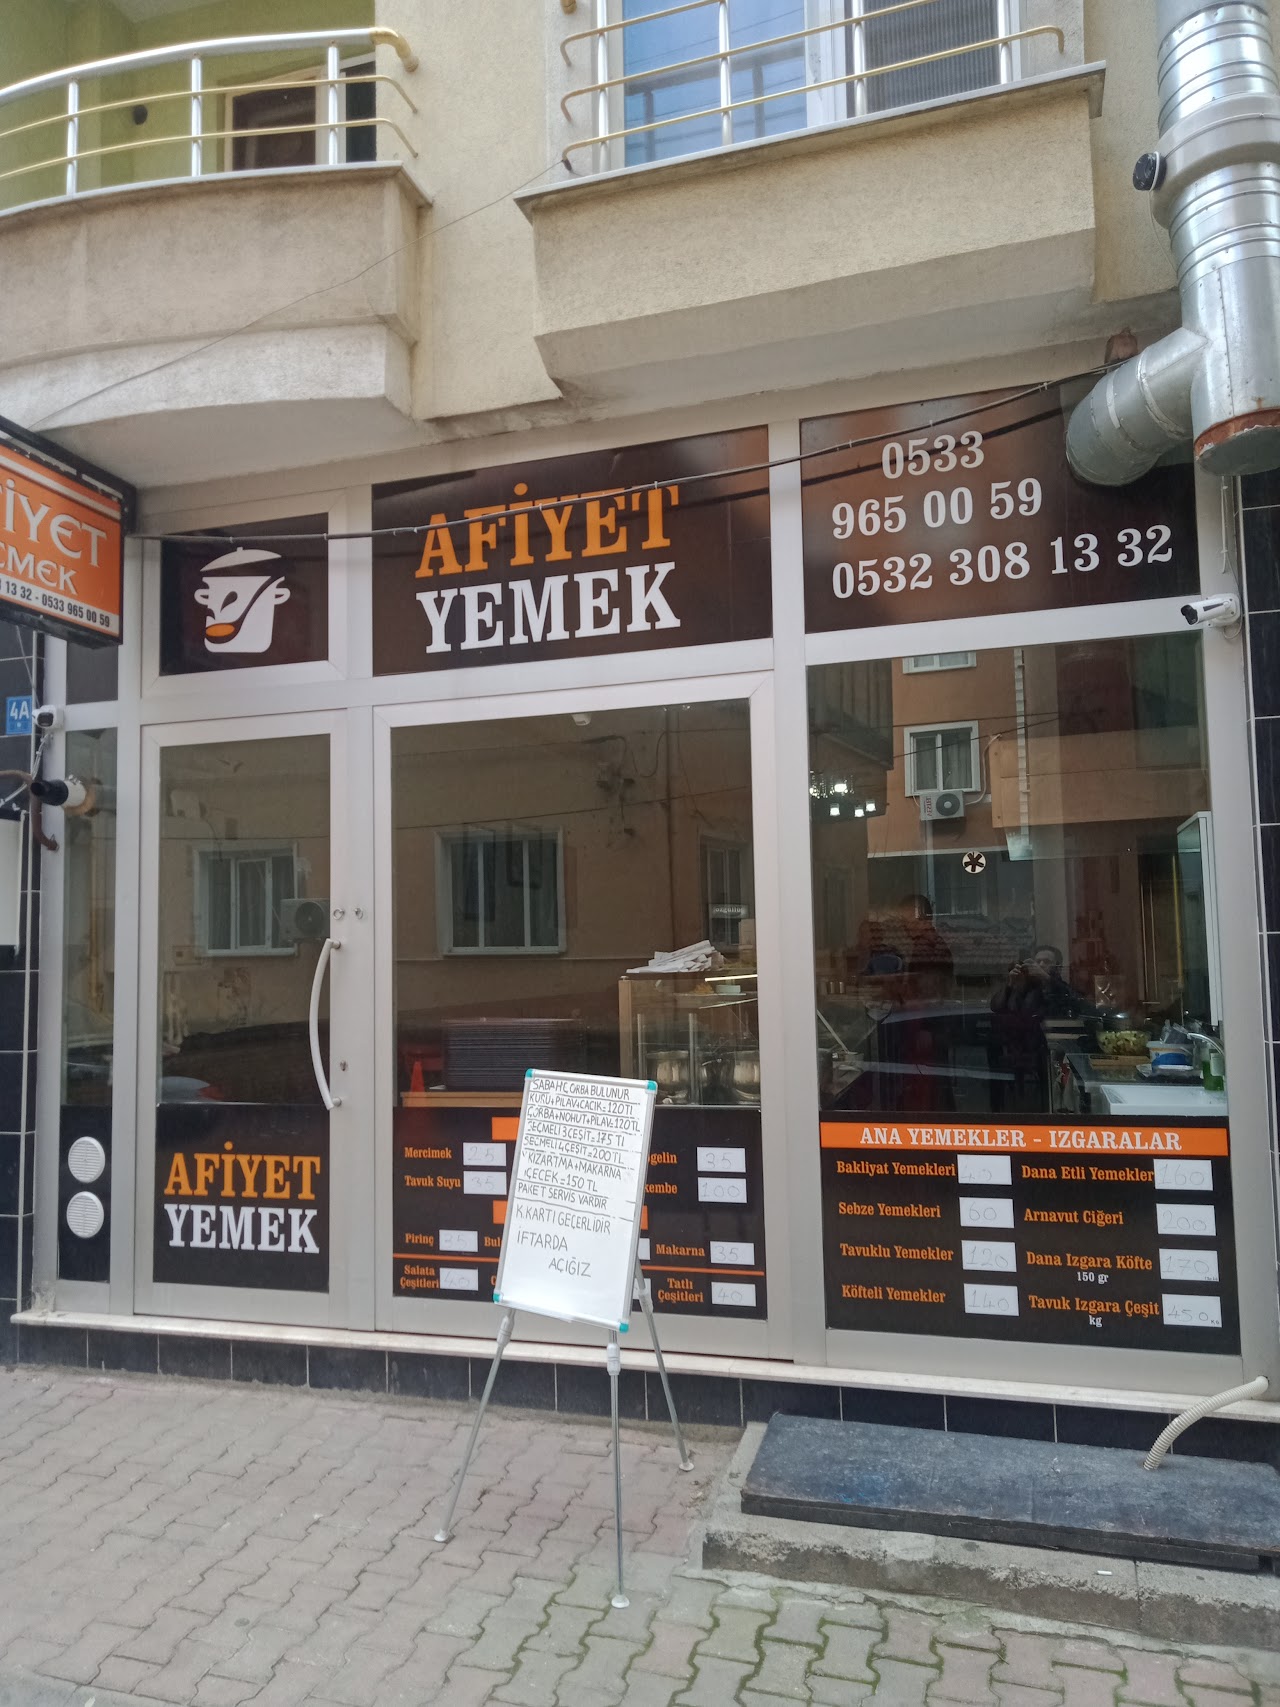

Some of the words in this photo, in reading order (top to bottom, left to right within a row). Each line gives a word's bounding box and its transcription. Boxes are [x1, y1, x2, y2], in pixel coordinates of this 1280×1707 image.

[882, 430, 985, 480] 0533
[832, 495, 907, 539] 965
[923, 486, 974, 528] 00
[990, 477, 1042, 519] 59
[0, 478, 107, 568] İYET
[415, 482, 679, 579] AFİYET
[832, 552, 933, 599] 0532
[949, 541, 1031, 586] 308
[1050, 532, 1100, 575] 13
[1117, 524, 1173, 567] 32
[6, 581, 17, 596] 13
[20, 587, 32, 601] 32
[42, 594, 65, 612] 0533
[67, 602, 84, 619] 965
[86, 609, 97, 623] 00
[99, 614, 110, 628] 59
[416, 561, 681, 654] YEMEK
[10, 700, 30, 720] 4A
[590, 1085, 630, 1101] BULUNUR
[860, 1127, 902, 1145] ANA
[907, 1128, 1026, 1148] YEMEKLER
[1049, 1130, 1182, 1151] IZGARALAR
[404, 1147, 452, 1159] Mercimek
[648, 1152, 678, 1166] gelin
[705, 1152, 732, 1170] 35
[164, 1141, 321, 1200] AFİYET
[837, 1160, 889, 1177] Bakliyat
[892, 1162, 956, 1176] Yemekleri
[1021, 1165, 1057, 1179] Dana
[1061, 1166, 1086, 1181] Etli
[1089, 1167, 1154, 1182] Yemekler
[1159, 1163, 1205, 1186] 160
[404, 1175, 434, 1188] Tavuk
[437, 1176, 461, 1190] Suyu
[518, 1181, 547, 1198] PAKET
[586, 1179, 598, 1193] TL
[701, 1182, 740, 1198] 100
[838, 1202, 874, 1216] Sebze
[877, 1203, 941, 1218] Yemekleri
[968, 1200, 998, 1222] 60
[1024, 1208, 1078, 1224] Arnavut
[1082, 1210, 1124, 1227] Ciğeri
[164, 1203, 320, 1254] YEMEK
[557, 1211, 611, 1236] GEÇERLİDİR
[1162, 1210, 1207, 1232] 200
[405, 1233, 434, 1246] Pirinç
[516, 1226, 569, 1252] İFTARDA
[656, 1244, 706, 1257] Makarna
[714, 1244, 740, 1262] 35
[840, 1243, 891, 1258] Tavuklu
[894, 1245, 954, 1261] Yemekler
[966, 1245, 1009, 1269] 120
[548, 1256, 592, 1278] AÇIĞIZ
[1026, 1251, 1062, 1266] Dana
[1066, 1253, 1112, 1270] Izgara
[1116, 1255, 1153, 1270] Köfte
[1161, 1255, 1210, 1274] 170
[404, 1264, 435, 1277] Salata
[1077, 1272, 1095, 1282] 150
[1098, 1274, 1109, 1284] gr
[400, 1277, 440, 1290] Çeşitleri
[667, 1277, 694, 1290] Tatlı
[658, 1289, 704, 1304] Çeşitleri
[717, 1290, 743, 1303] 40
[842, 1284, 883, 1299] Köfteli
[886, 1287, 945, 1303] Yemekler
[968, 1289, 1010, 1311] 140
[1029, 1295, 1071, 1310] Tavuk
[1075, 1297, 1120, 1315] Izgara
[1124, 1300, 1160, 1318] Çeşit
[1167, 1304, 1209, 1322] 450
[1089, 1315, 1103, 1327] kg
